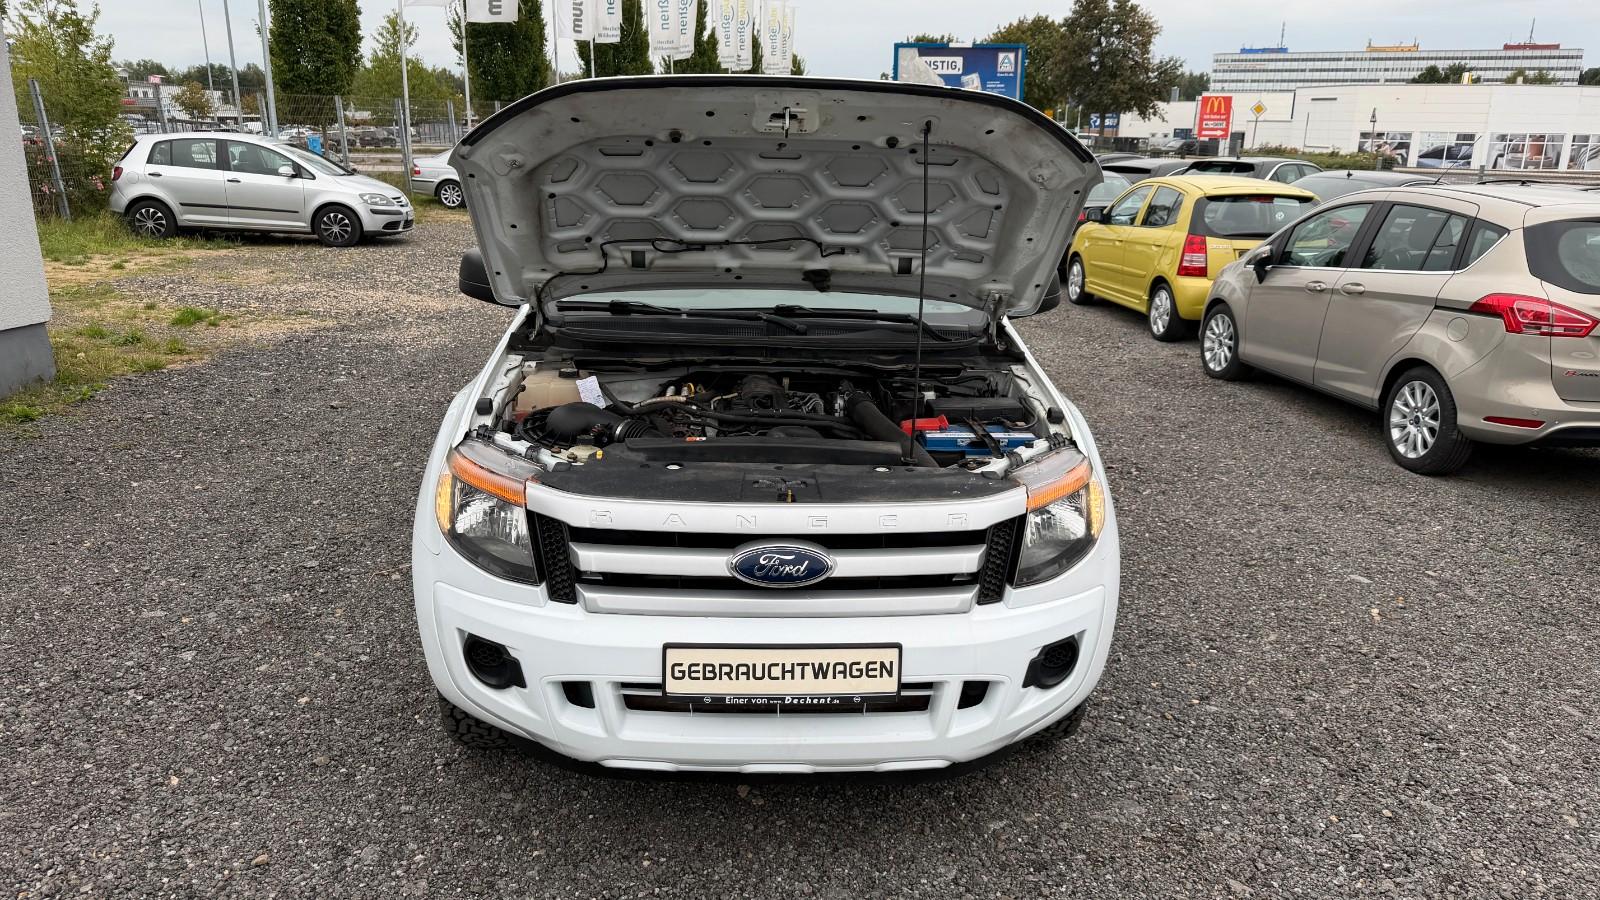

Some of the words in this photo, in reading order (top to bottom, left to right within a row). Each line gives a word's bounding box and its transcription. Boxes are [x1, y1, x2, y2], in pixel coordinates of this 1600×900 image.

[572, 0, 583, 33] mul
[590, 509, 969, 529] RANGER
[753, 553, 809, 577] Ford
[670, 660, 894, 681] GEBRAUCHTWAGEN
[725, 696, 748, 704] Einer
